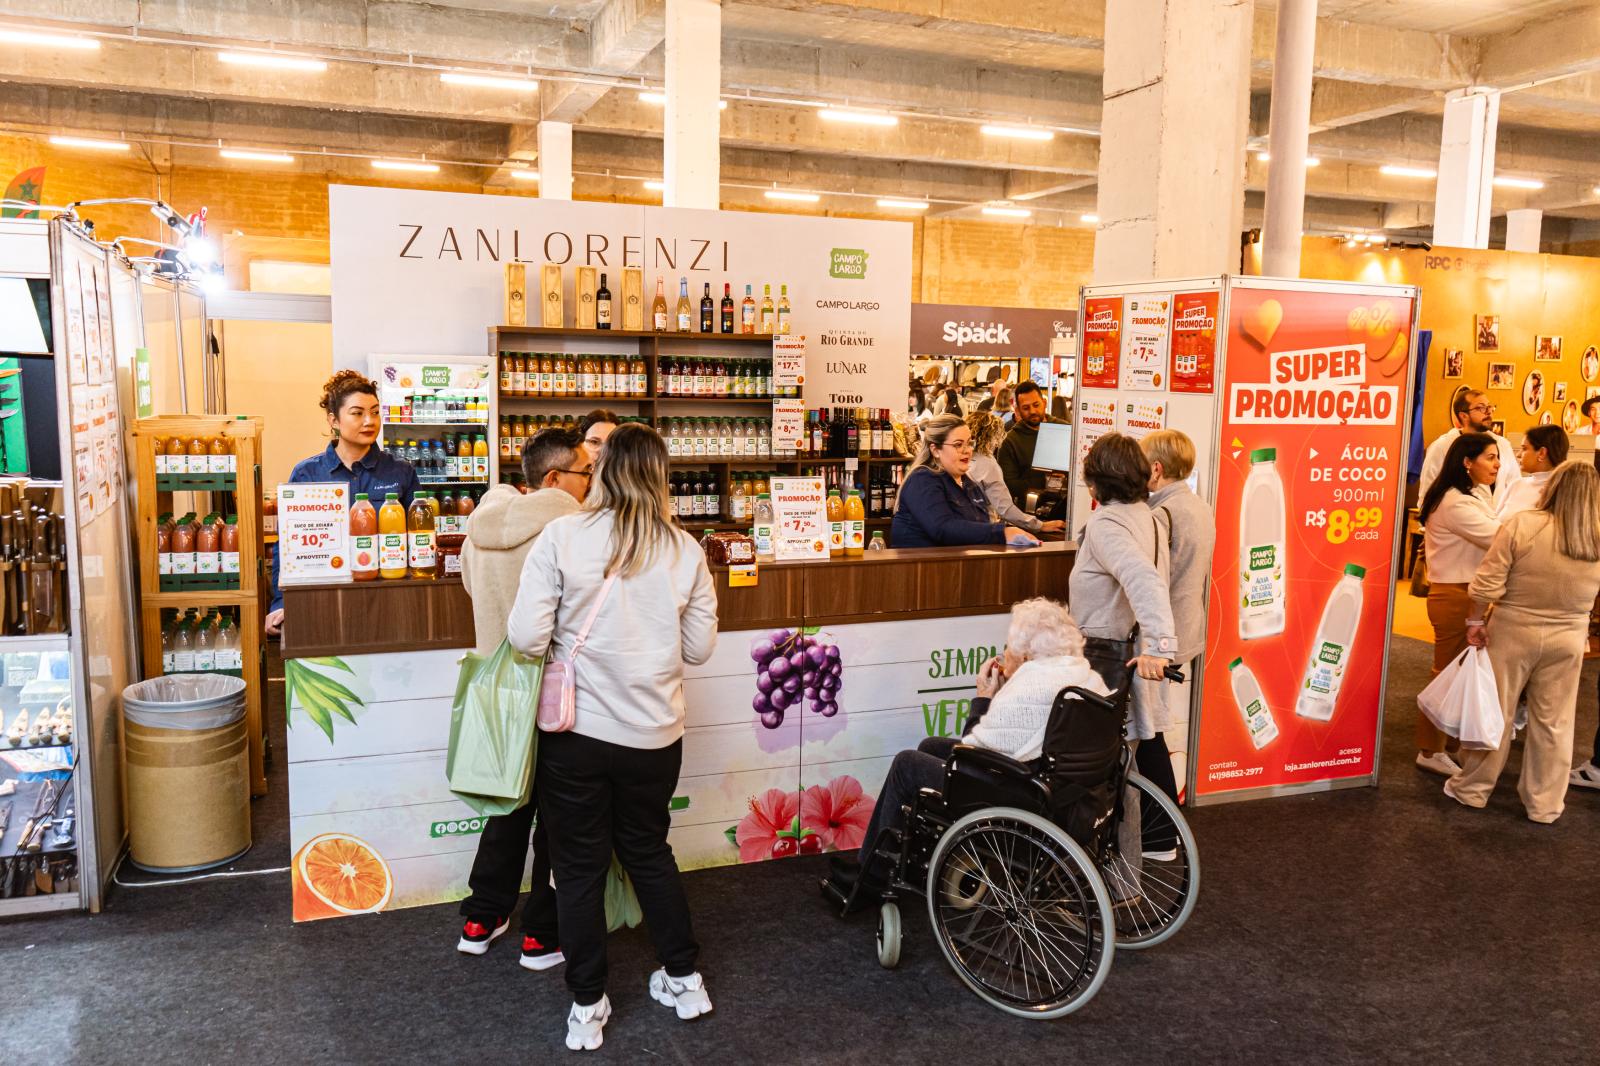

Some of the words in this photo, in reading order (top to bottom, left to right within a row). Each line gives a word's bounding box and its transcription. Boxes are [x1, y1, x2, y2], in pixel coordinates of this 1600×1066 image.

[397, 223, 729, 273] ZANLORENZI
[833, 253, 862, 264] CAMPO
[1424, 255, 1451, 270] RPC
[833, 264, 862, 275] LARGO
[1094, 311, 1112, 321] SUPER
[1184, 307, 1205, 319] SUPER
[820, 334, 838, 346] RIO
[840, 334, 874, 347] GRANDE
[942, 320, 1011, 347] Spack
[425, 369, 447, 377] CAMPO
[826, 360, 867, 375] LUNAR
[1275, 348, 1361, 384] SUPER
[828, 393, 863, 404] TORO
[1235, 385, 1392, 425] PROMOÇÃO
[1341, 443, 1389, 461] ÁGUA
[1309, 467, 1332, 482] DE
[1338, 467, 1387, 482] COCO
[1333, 487, 1385, 503] 900ml
[1354, 529, 1379, 541] cada
[1338, 747, 1362, 756] acesse
[1209, 760, 1238, 770] contato
[1284, 756, 1362, 772] loja.zanlorenzi.com.br
